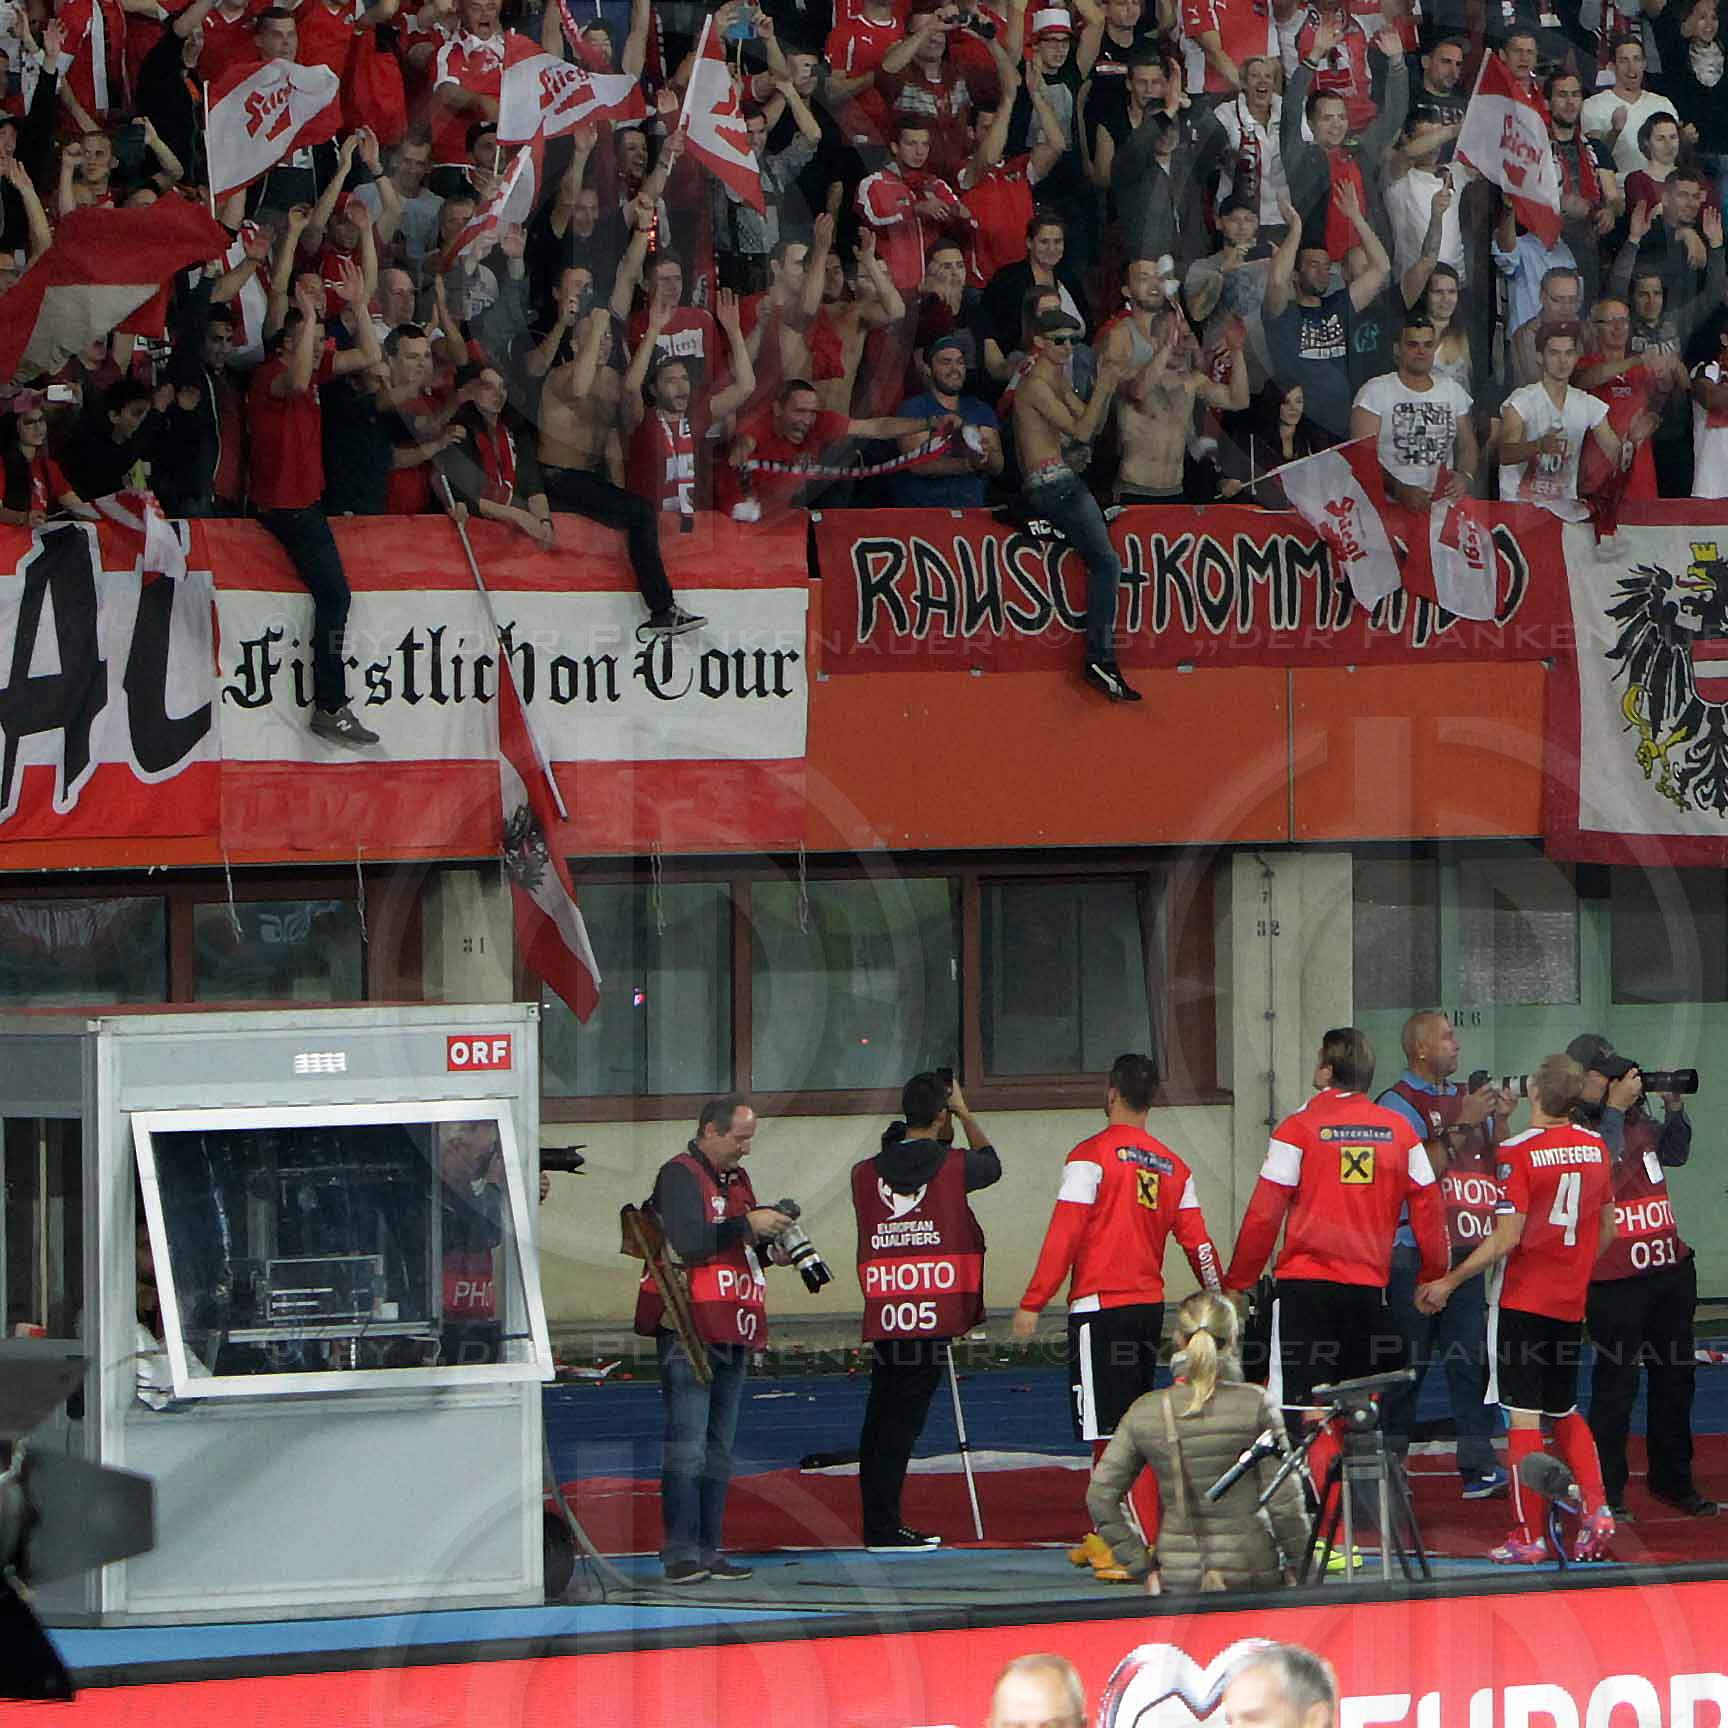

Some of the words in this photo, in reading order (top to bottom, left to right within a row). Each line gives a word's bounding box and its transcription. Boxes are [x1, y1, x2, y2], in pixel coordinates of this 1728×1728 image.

[549, 654, 622, 706] on
[631, 627, 800, 700] Tour
[450, 1040, 509, 1064] ORF
[1549, 1172, 1582, 1246] 4
[871, 1231, 941, 1249] QUALIFIERS
[877, 1220, 934, 1234] EUROPEAN
[1630, 1237, 1677, 1270] 031
[866, 1262, 955, 1292] PHOTO
[881, 1301, 938, 1332] 005
